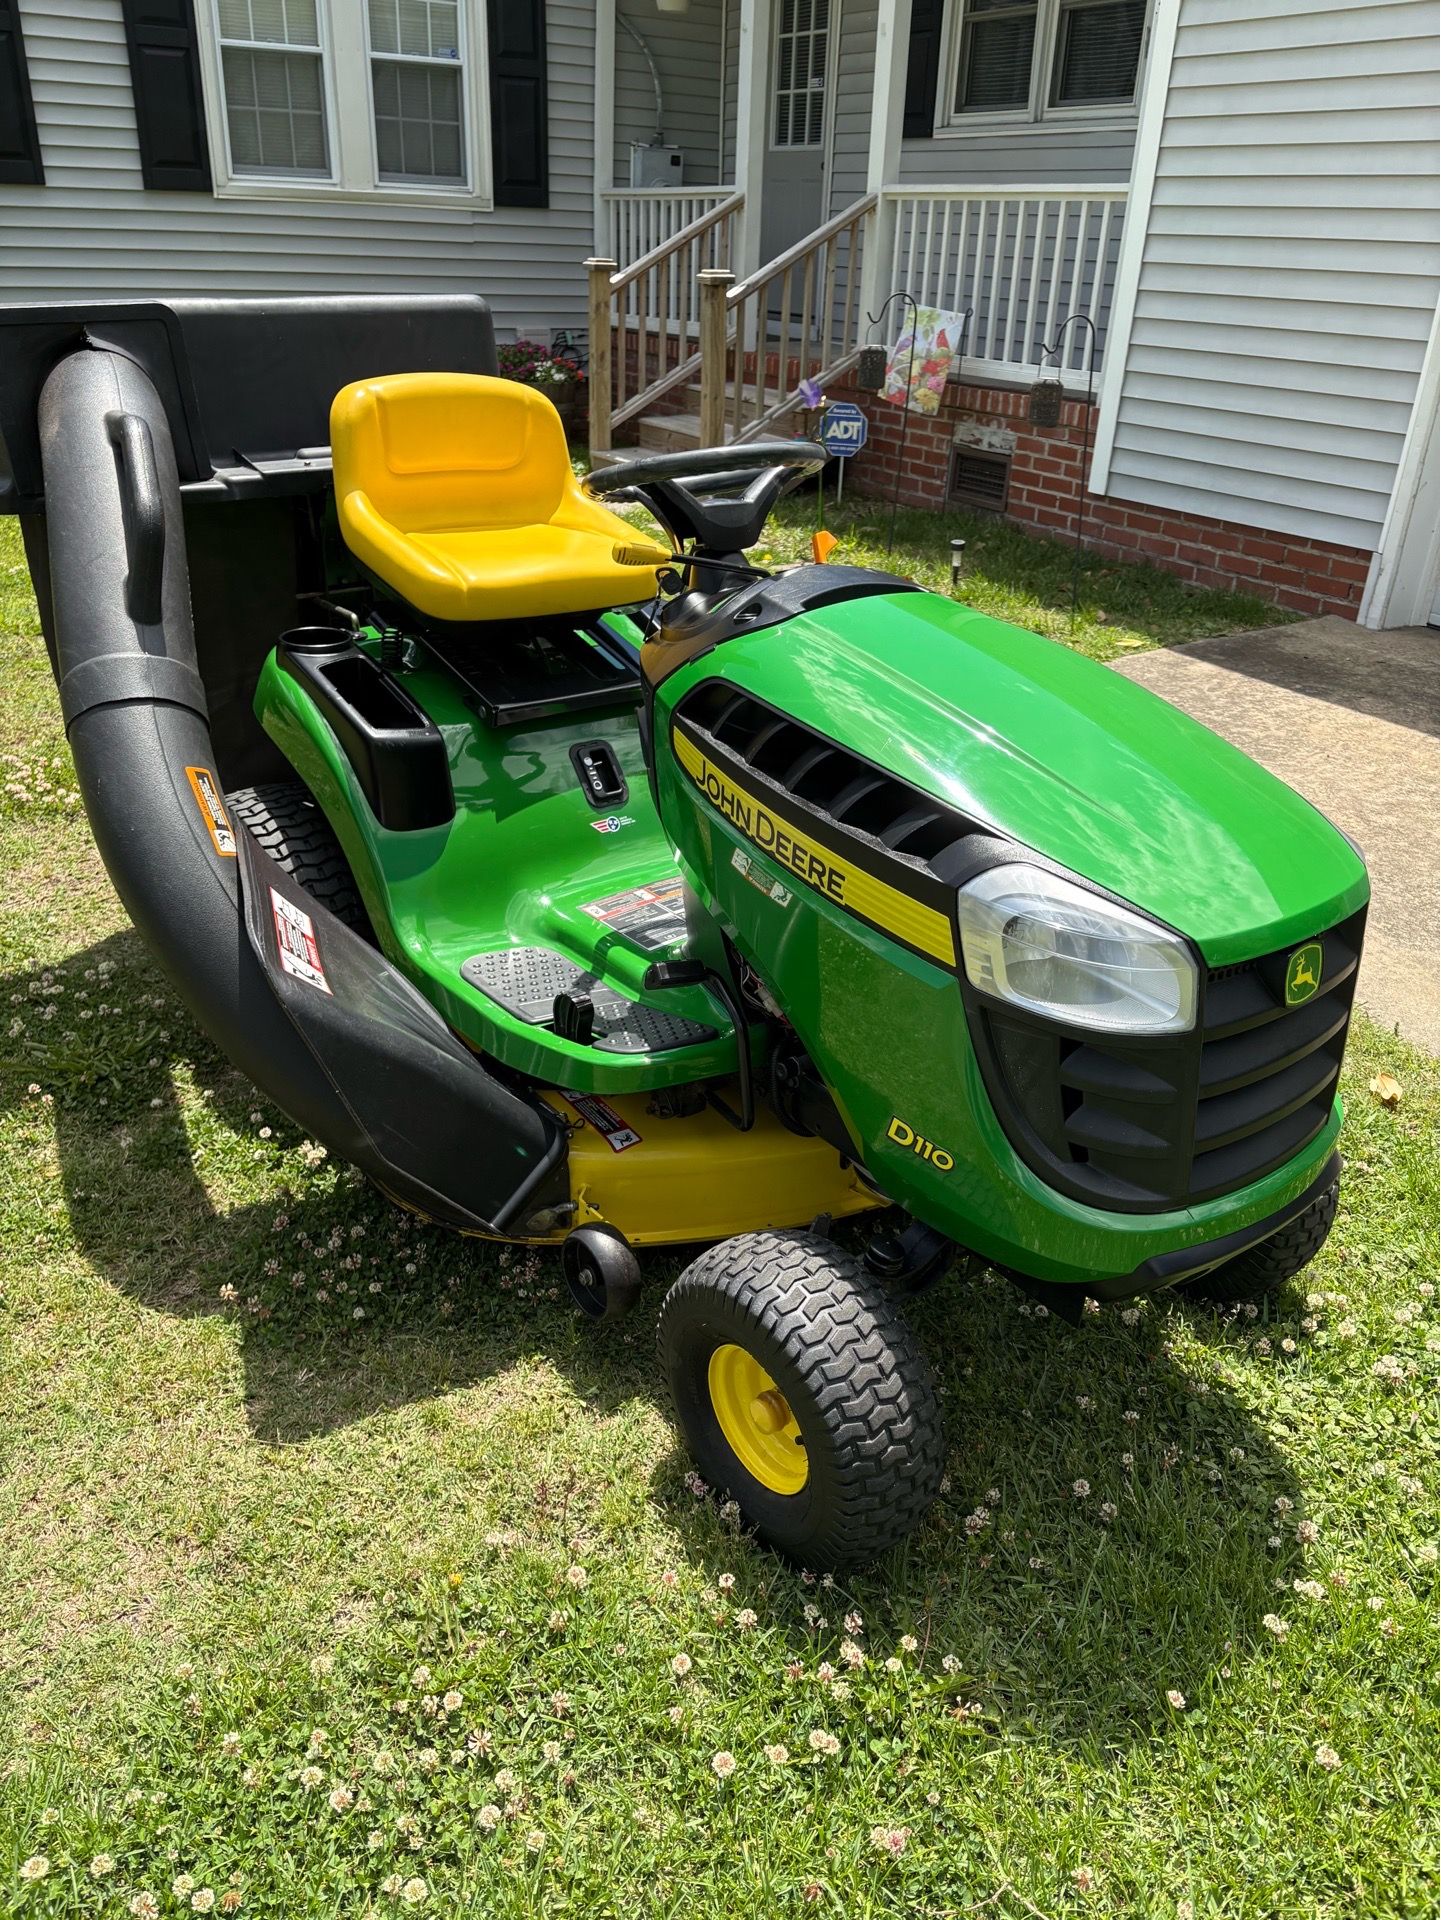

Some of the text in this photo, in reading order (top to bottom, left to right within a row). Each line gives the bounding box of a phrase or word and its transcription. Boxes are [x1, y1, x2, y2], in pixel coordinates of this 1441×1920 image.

[826, 421, 862, 440] ADT
[696, 760, 846, 901] JOHN DEERE
[887, 1116, 954, 1170] D110
